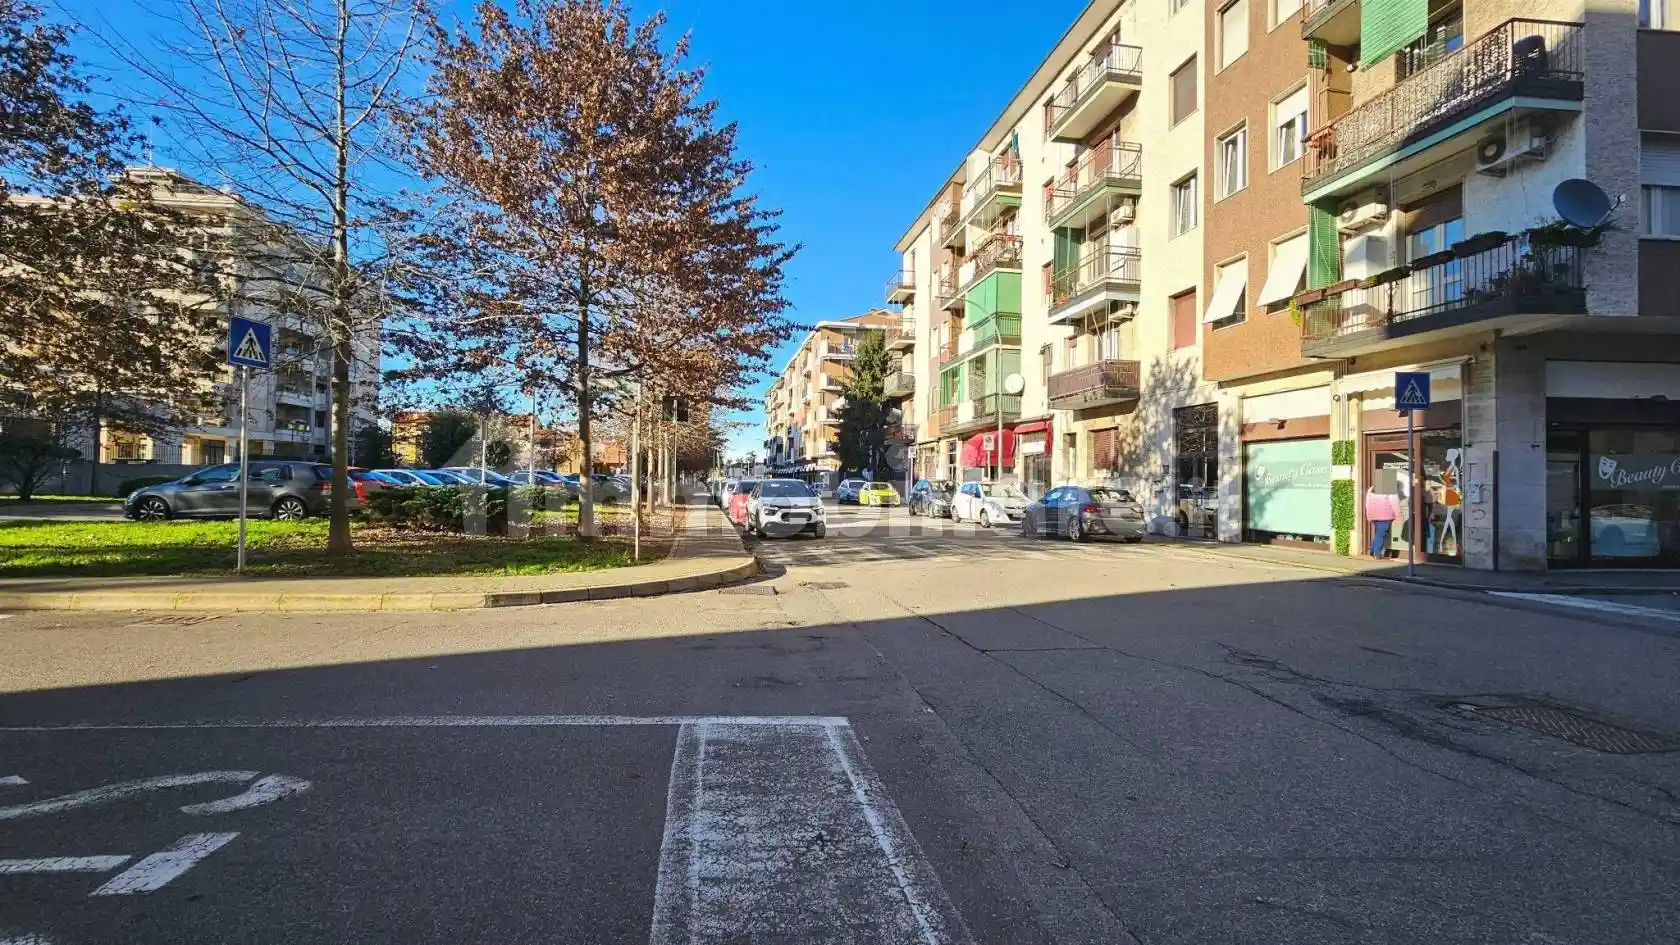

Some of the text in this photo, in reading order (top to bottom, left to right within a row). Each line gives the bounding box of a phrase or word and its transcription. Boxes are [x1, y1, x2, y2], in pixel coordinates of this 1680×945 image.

[1261, 468, 1298, 487] Beauty
[1300, 461, 1326, 475] Case
[1610, 465, 1667, 488] Beauty
